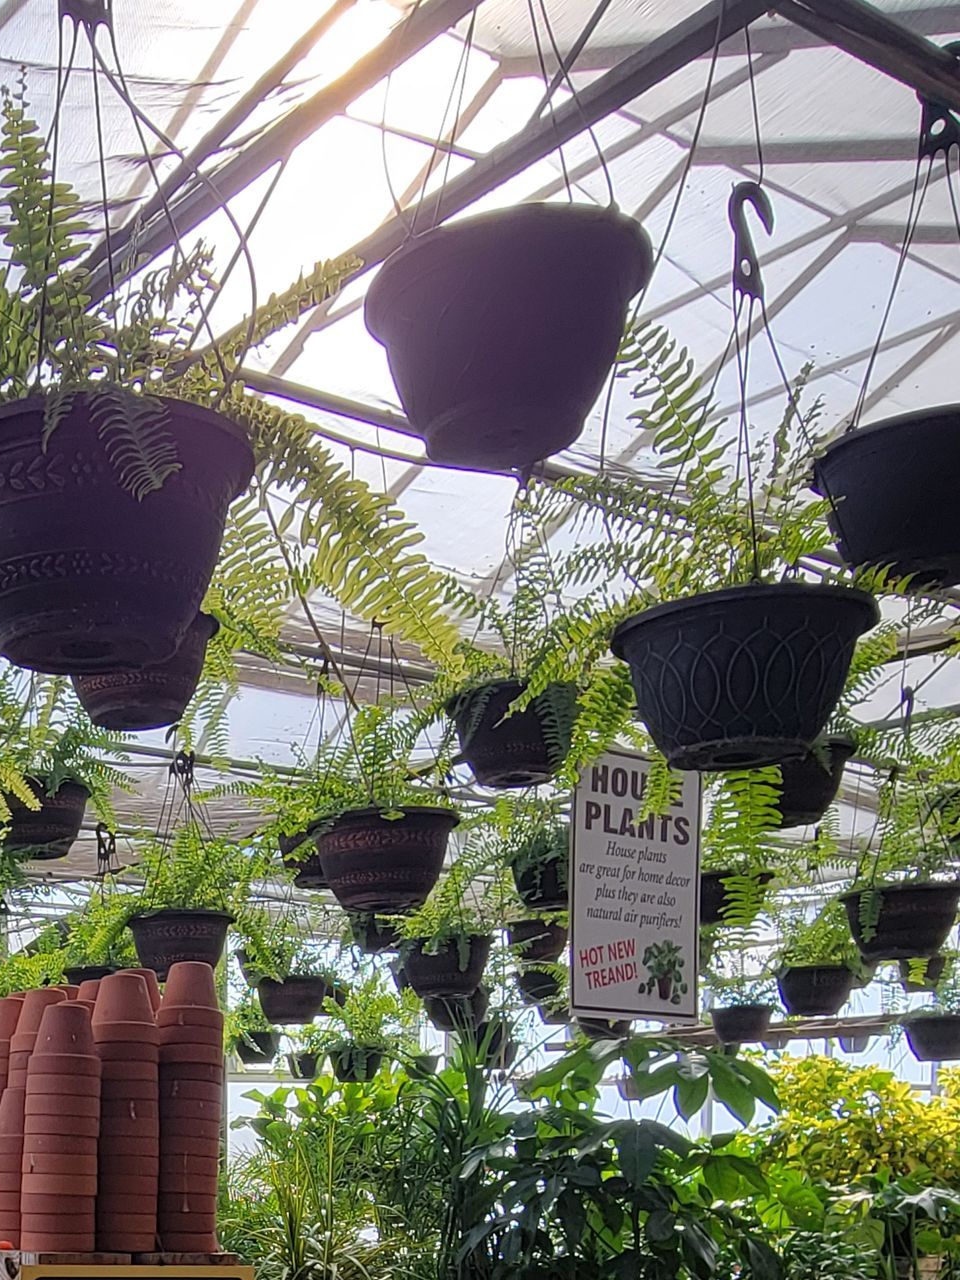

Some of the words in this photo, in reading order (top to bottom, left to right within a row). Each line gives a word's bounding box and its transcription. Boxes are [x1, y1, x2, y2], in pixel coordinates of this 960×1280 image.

[591, 765, 684, 808] HOUE
[585, 800, 690, 846] PLANTS
[606, 840, 637, 860] House
[637, 846, 668, 864] plants
[579, 862, 595, 875] are
[595, 864, 621, 880] great
[619, 864, 637, 883] for
[638, 866, 665, 885] home
[666, 871, 691, 888] decor
[594, 882, 616, 901] plus
[618, 885, 639, 906] they
[640, 892, 656, 905] are
[657, 891, 677, 907] also
[586, 907, 623, 922] natural
[623, 909, 639, 923] air
[639, 911, 683, 930] purifiers!
[579, 946, 604, 969] HOT
[607, 938, 636, 962] NEW
[584, 961, 638, 991] TREAND!
